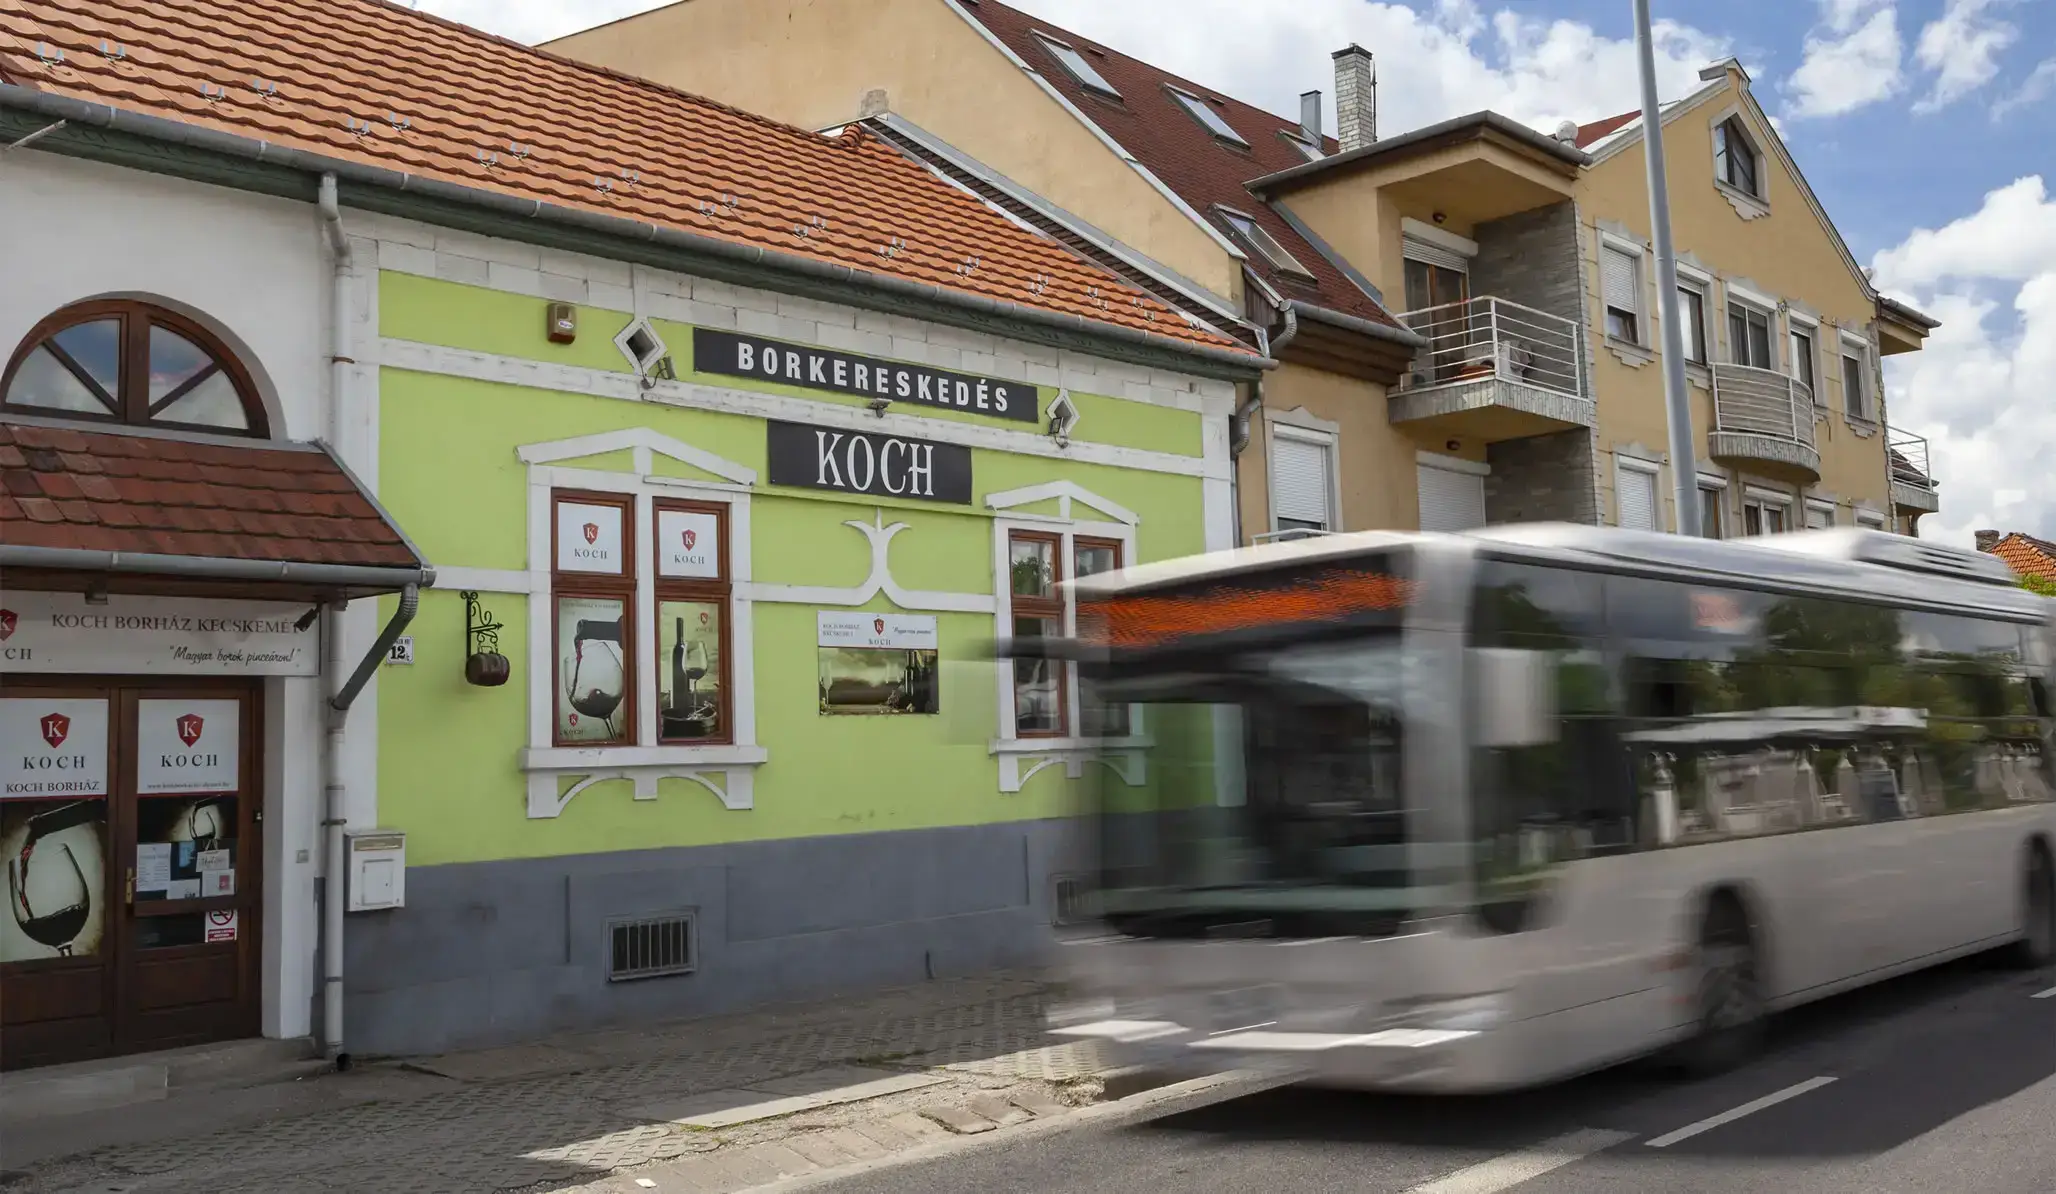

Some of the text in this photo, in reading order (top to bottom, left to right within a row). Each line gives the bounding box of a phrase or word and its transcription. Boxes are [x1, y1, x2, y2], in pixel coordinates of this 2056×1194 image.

[738, 342, 1008, 412] BORKERESKEDÉS
[815, 431, 935, 496] KOCH
[587, 528, 595, 539] K
[685, 534, 693, 545] K
[574, 548, 608, 559] KOCH
[674, 555, 705, 565] KOCH
[52, 614, 107, 629] KOCH
[115, 615, 192, 631] BORHÁZ
[868, 638, 891, 646] KOCH
[217, 648, 243, 662] borok
[48, 720, 63, 737] K
[183, 721, 198, 737] K
[23, 756, 85, 769] KOCH
[161, 754, 218, 768] KOCH
[6, 779, 100, 793] KOCH BORHÁZ
